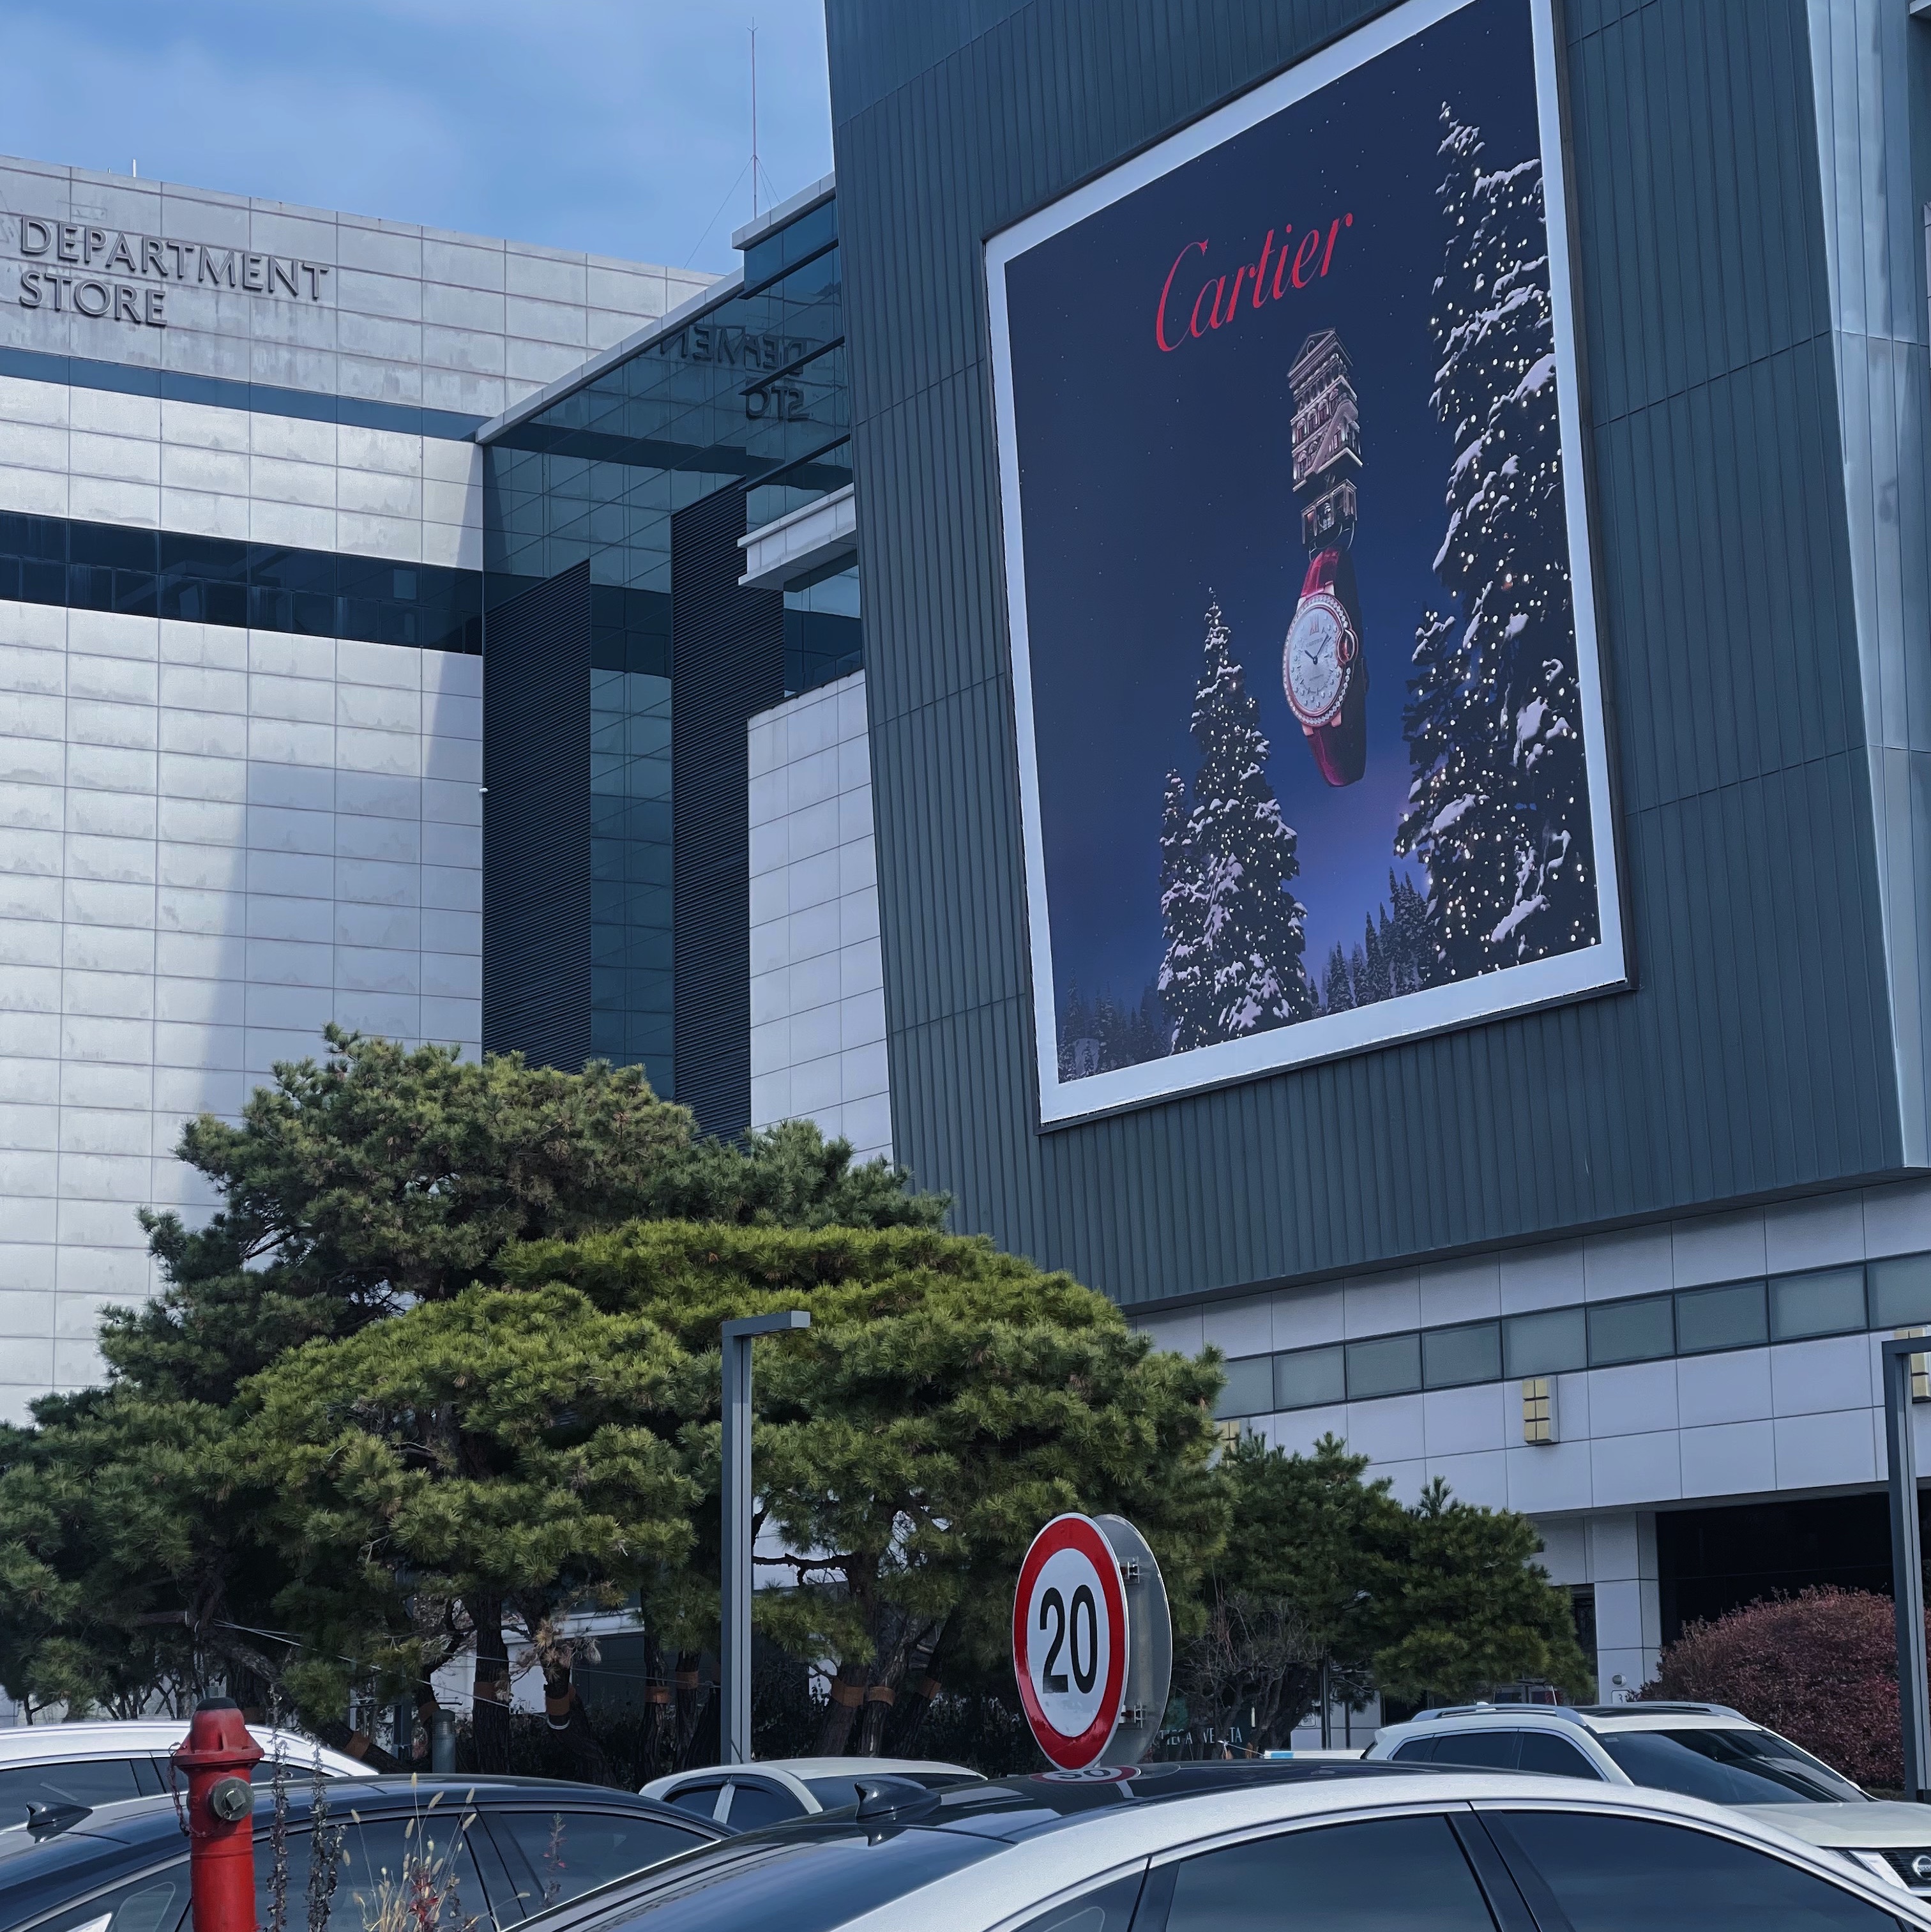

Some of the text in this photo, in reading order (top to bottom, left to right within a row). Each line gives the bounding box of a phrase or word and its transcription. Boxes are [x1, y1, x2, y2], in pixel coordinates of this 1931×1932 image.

[19, 269, 169, 327] STORE
[20, 216, 329, 300] DEPARTMENT
[1156, 212, 1353, 352] Cartier
[1039, 1584, 1098, 1694] 20
[1203, 1726, 1243, 1744] VETA
